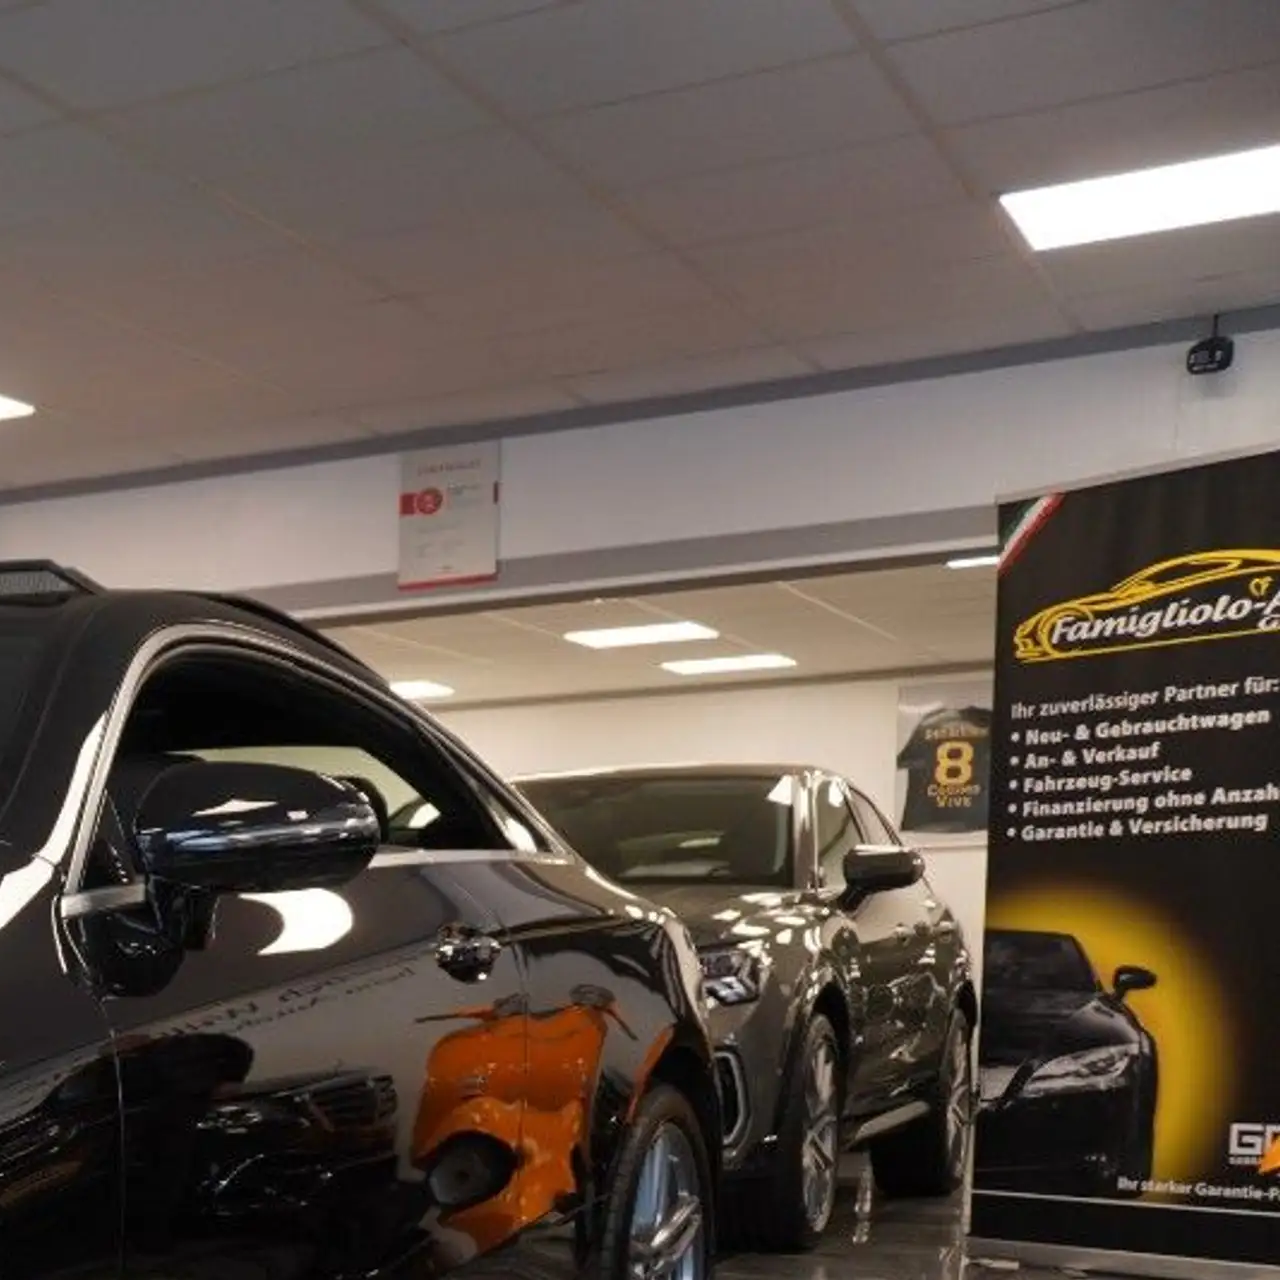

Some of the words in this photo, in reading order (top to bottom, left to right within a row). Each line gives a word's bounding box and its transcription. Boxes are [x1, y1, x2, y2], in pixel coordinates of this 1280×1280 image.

[1011, 703, 1036, 719] Ihr
[1040, 691, 1158, 716] zuverlässiger
[1164, 682, 1239, 703] Partner
[1025, 729, 1069, 745] Neu-
[1074, 724, 1090, 740] &
[1095, 710, 1270, 738] Gebrauchtwagen
[934, 740, 974, 784] 8
[1024, 753, 1056, 769] An-
[1061, 750, 1076, 766] &
[1082, 741, 1161, 764] Verkauf
[1023, 765, 1192, 793] Fahrzeug-Service
[1022, 796, 1149, 817] Finanzierung
[1154, 790, 1206, 807] ohne
[1021, 821, 1105, 841] Garantie
[1109, 819, 1123, 836] &
[1128, 813, 1269, 836] Versicherung
[1195, 1182, 1280, 1201] Garantie-P
